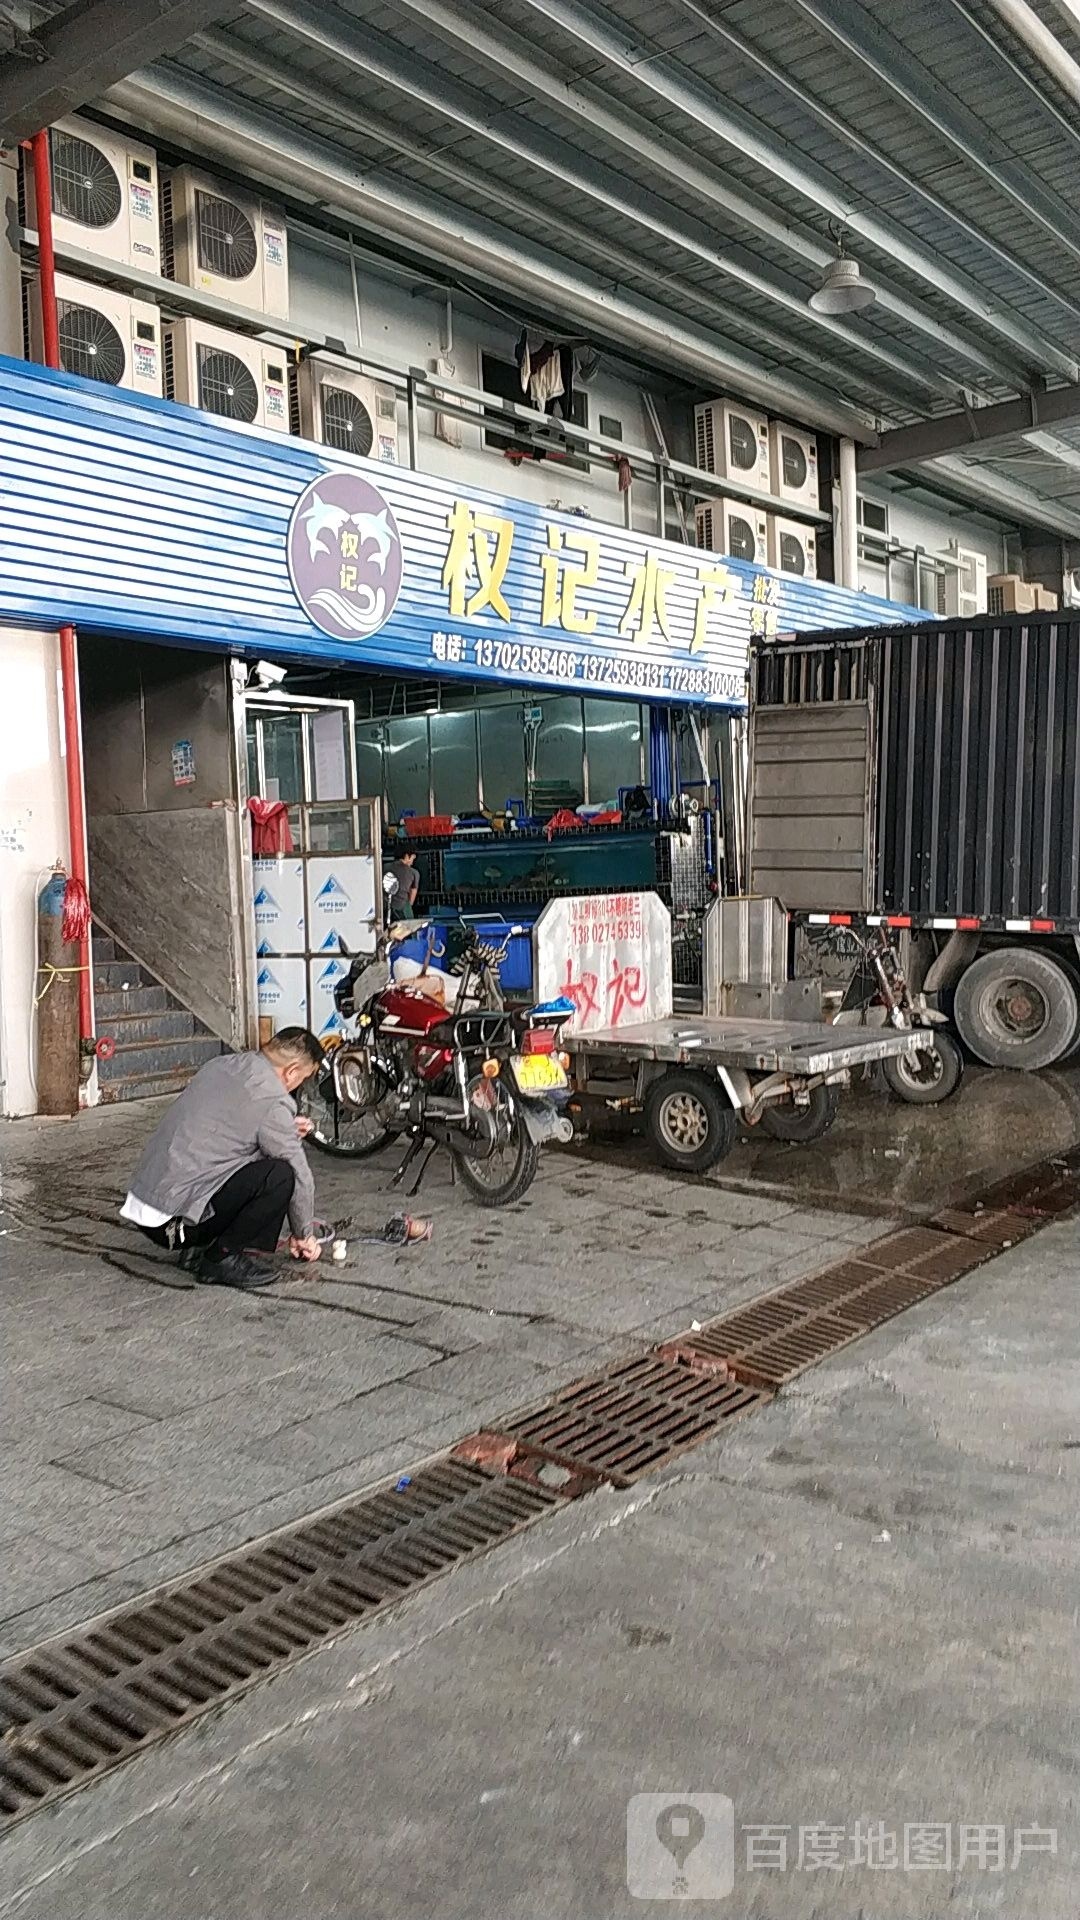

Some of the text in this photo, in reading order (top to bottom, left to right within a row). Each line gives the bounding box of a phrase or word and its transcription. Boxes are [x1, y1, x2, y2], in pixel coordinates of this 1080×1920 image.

[340, 531, 359, 592] 权记
[442, 500, 743, 655] 权记水产
[560, 958, 648, 1028] 权记
